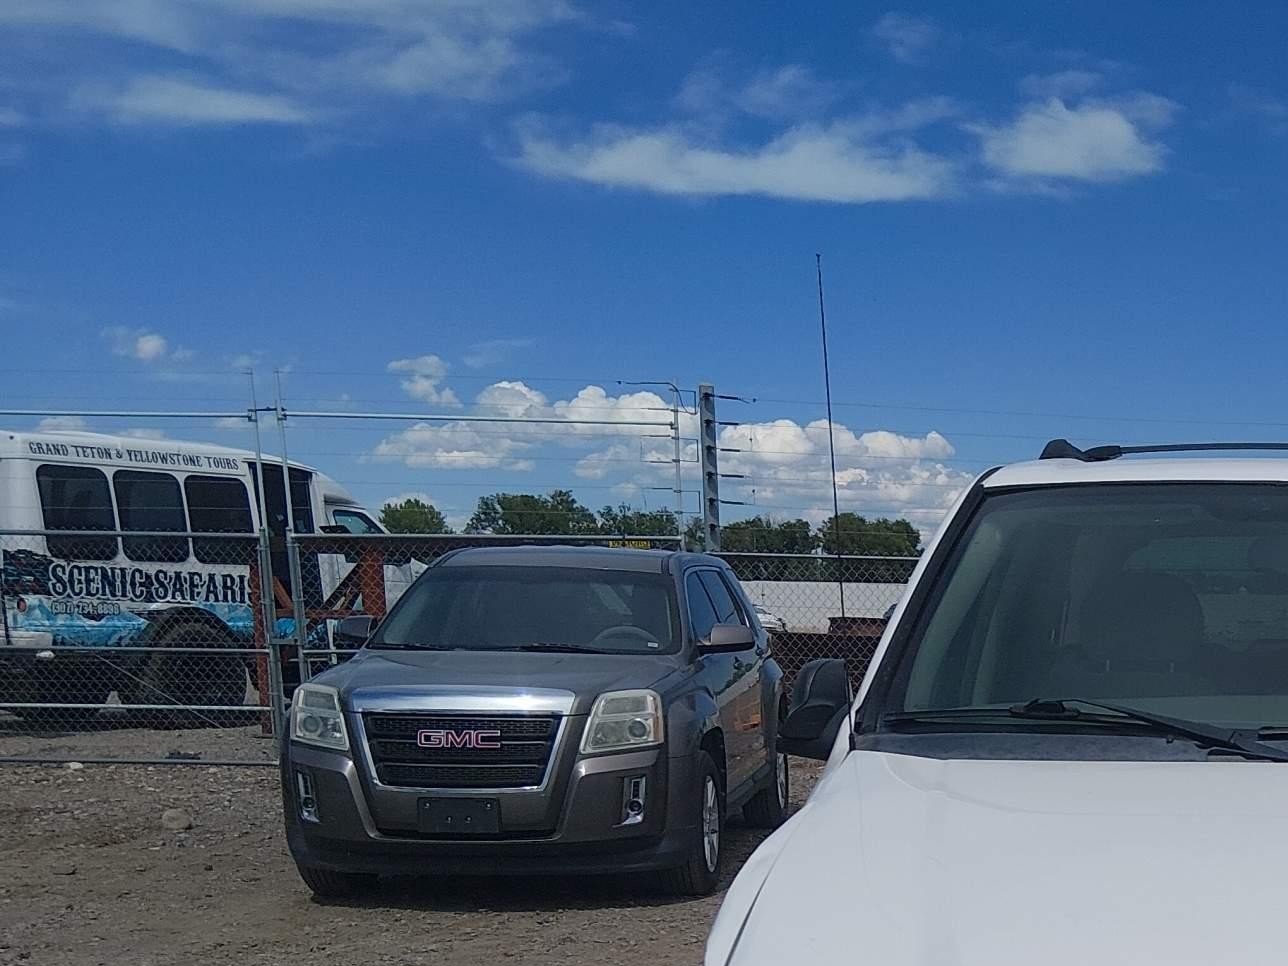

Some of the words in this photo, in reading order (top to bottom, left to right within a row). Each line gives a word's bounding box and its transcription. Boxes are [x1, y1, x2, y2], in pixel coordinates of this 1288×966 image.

[28, 442, 69, 457] GRAND
[71, 445, 112, 460] TETON
[115, 450, 123, 459] &
[126, 449, 203, 468] YELLOWSTONE
[203, 456, 240, 471] TOURS
[50, 562, 147, 601] SCENIC
[151, 569, 252, 607] SAFARI
[51, 600, 75, 616] (307)
[417, 729, 501, 748] GMC
